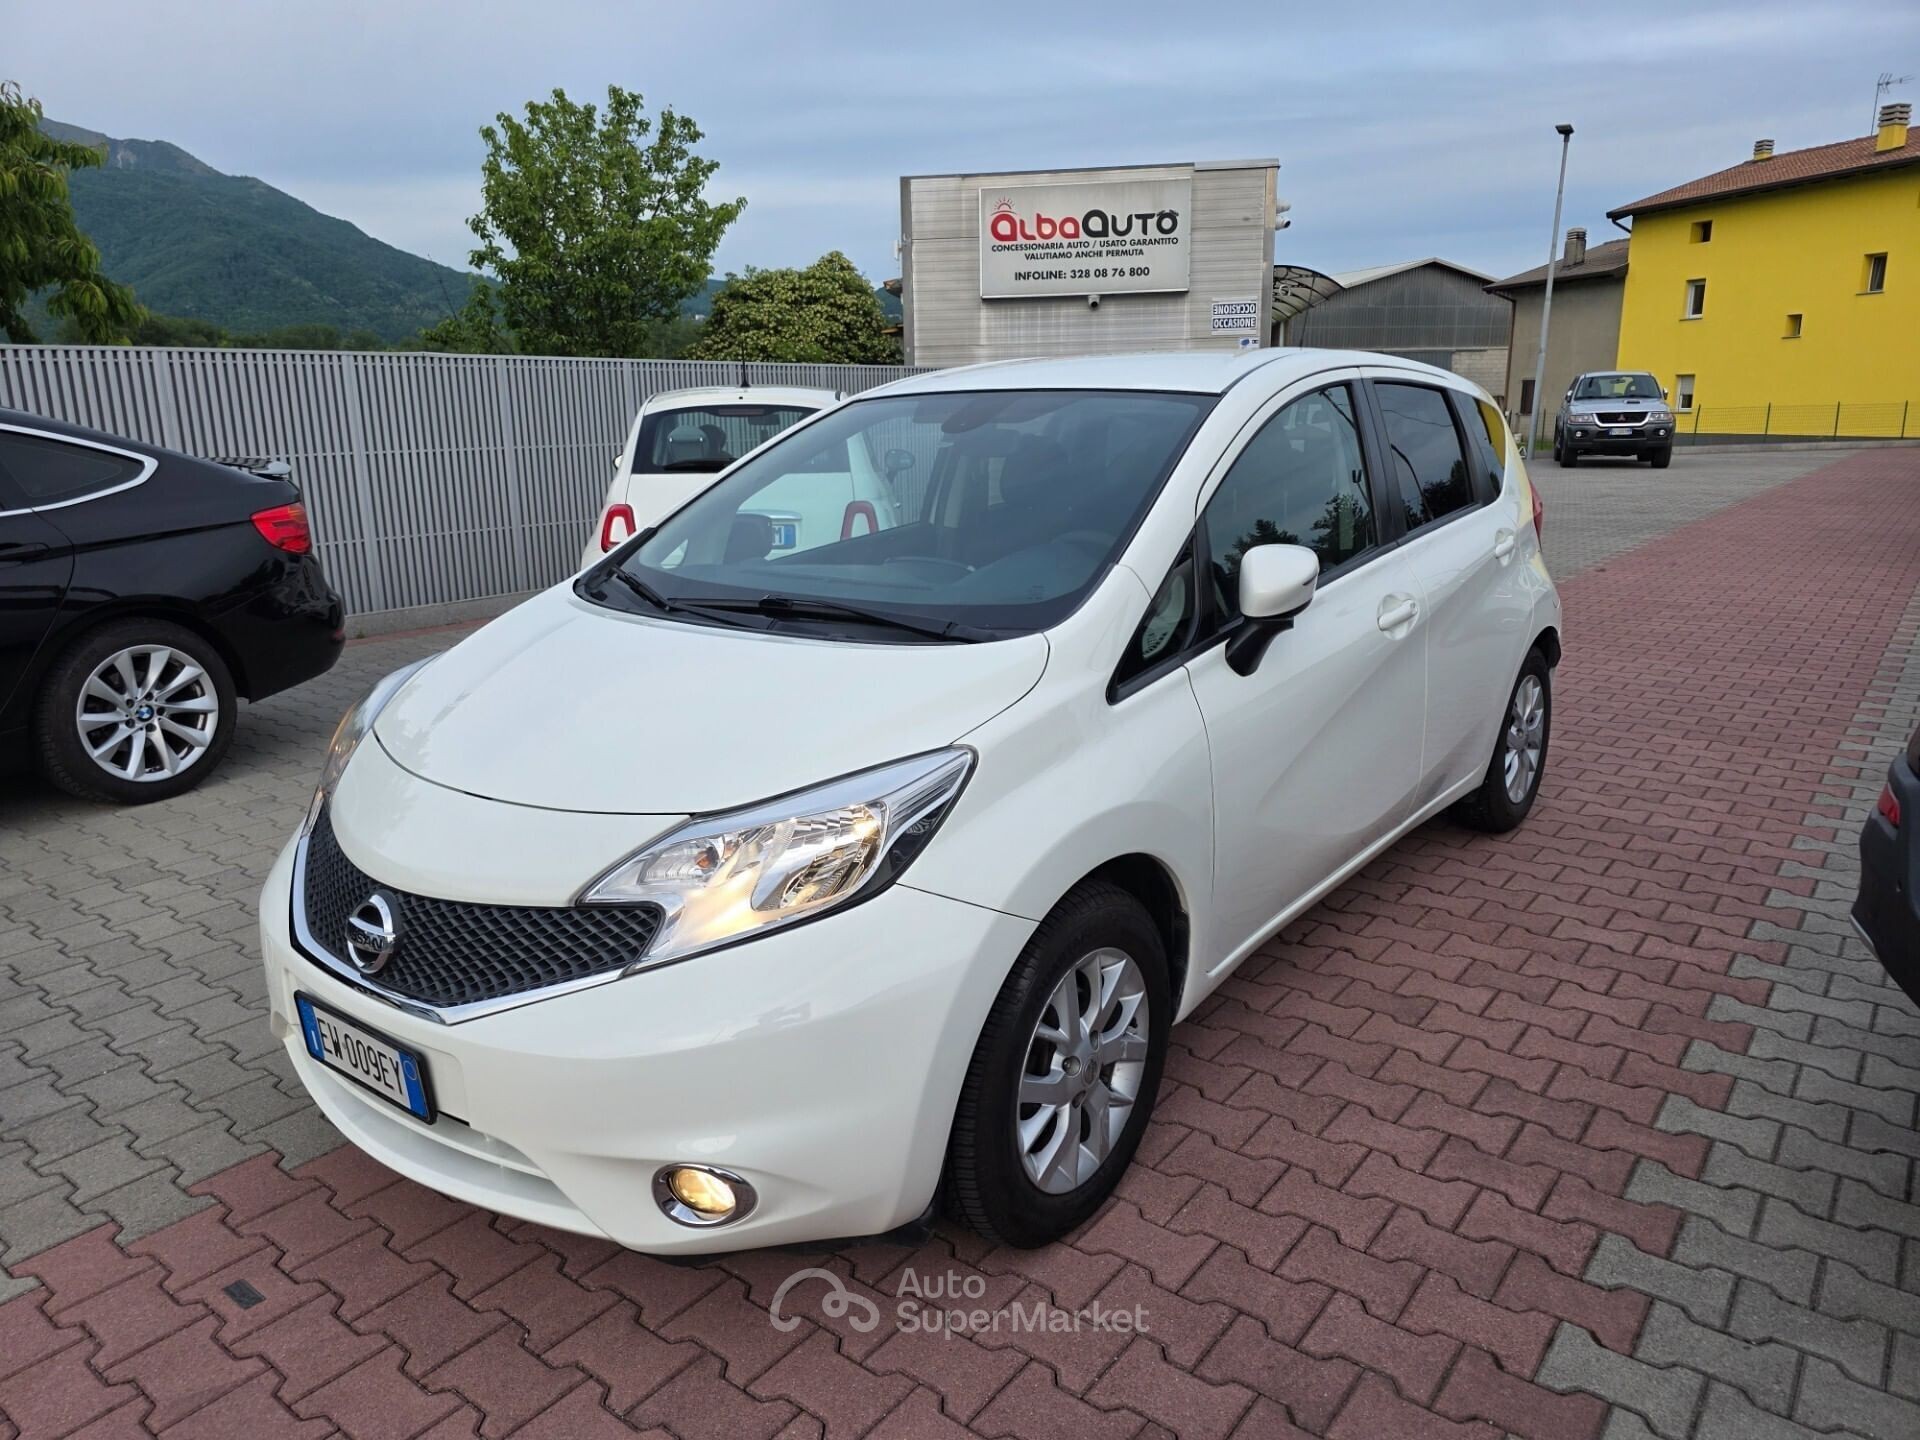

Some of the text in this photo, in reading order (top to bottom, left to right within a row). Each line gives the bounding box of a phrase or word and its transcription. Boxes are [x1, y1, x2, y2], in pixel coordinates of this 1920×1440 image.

[991, 242, 1064, 252] CONCESSIONARIA
[1066, 241, 1090, 249] AUTO
[1099, 239, 1127, 248] USATO
[1129, 237, 1178, 246] GARANTITO
[1024, 248, 1144, 260] VALUTIAMO ANCHE PERMUTA
[1014, 266, 1150, 281] INFOLINE: 328 08 76 800
[1213, 317, 1256, 328] OCCASIONE
[344, 1033, 403, 1095] 009EY
